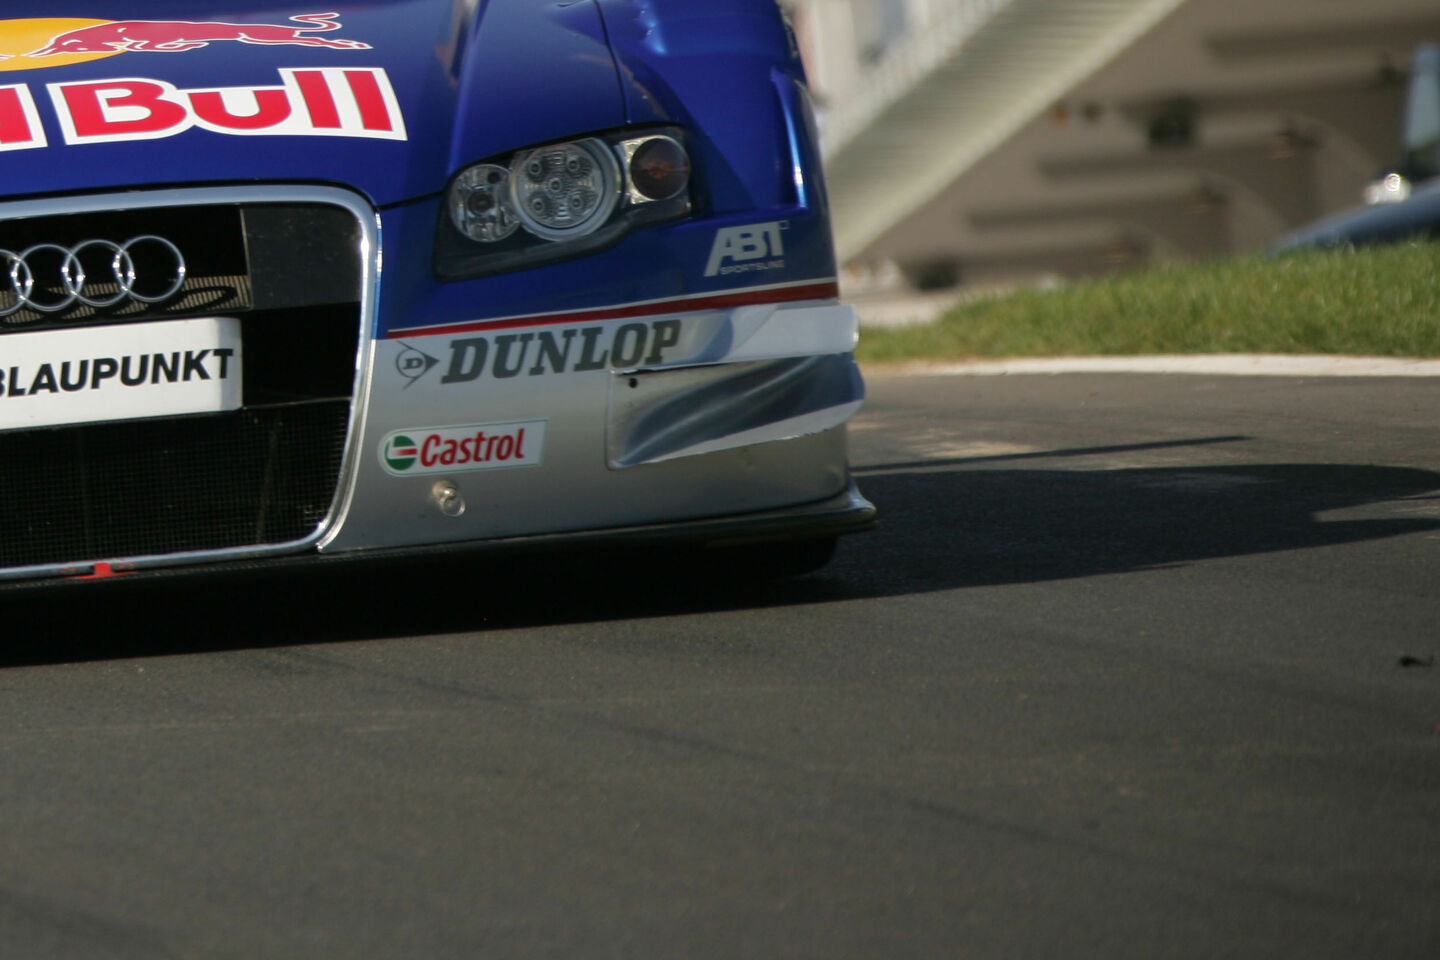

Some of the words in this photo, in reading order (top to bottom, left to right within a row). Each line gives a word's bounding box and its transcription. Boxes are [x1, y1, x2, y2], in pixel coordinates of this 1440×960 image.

[63, 69, 396, 138] Bull
[703, 221, 784, 277] ABT
[440, 319, 682, 385] DUNLOP
[419, 428, 525, 468] Castrol
